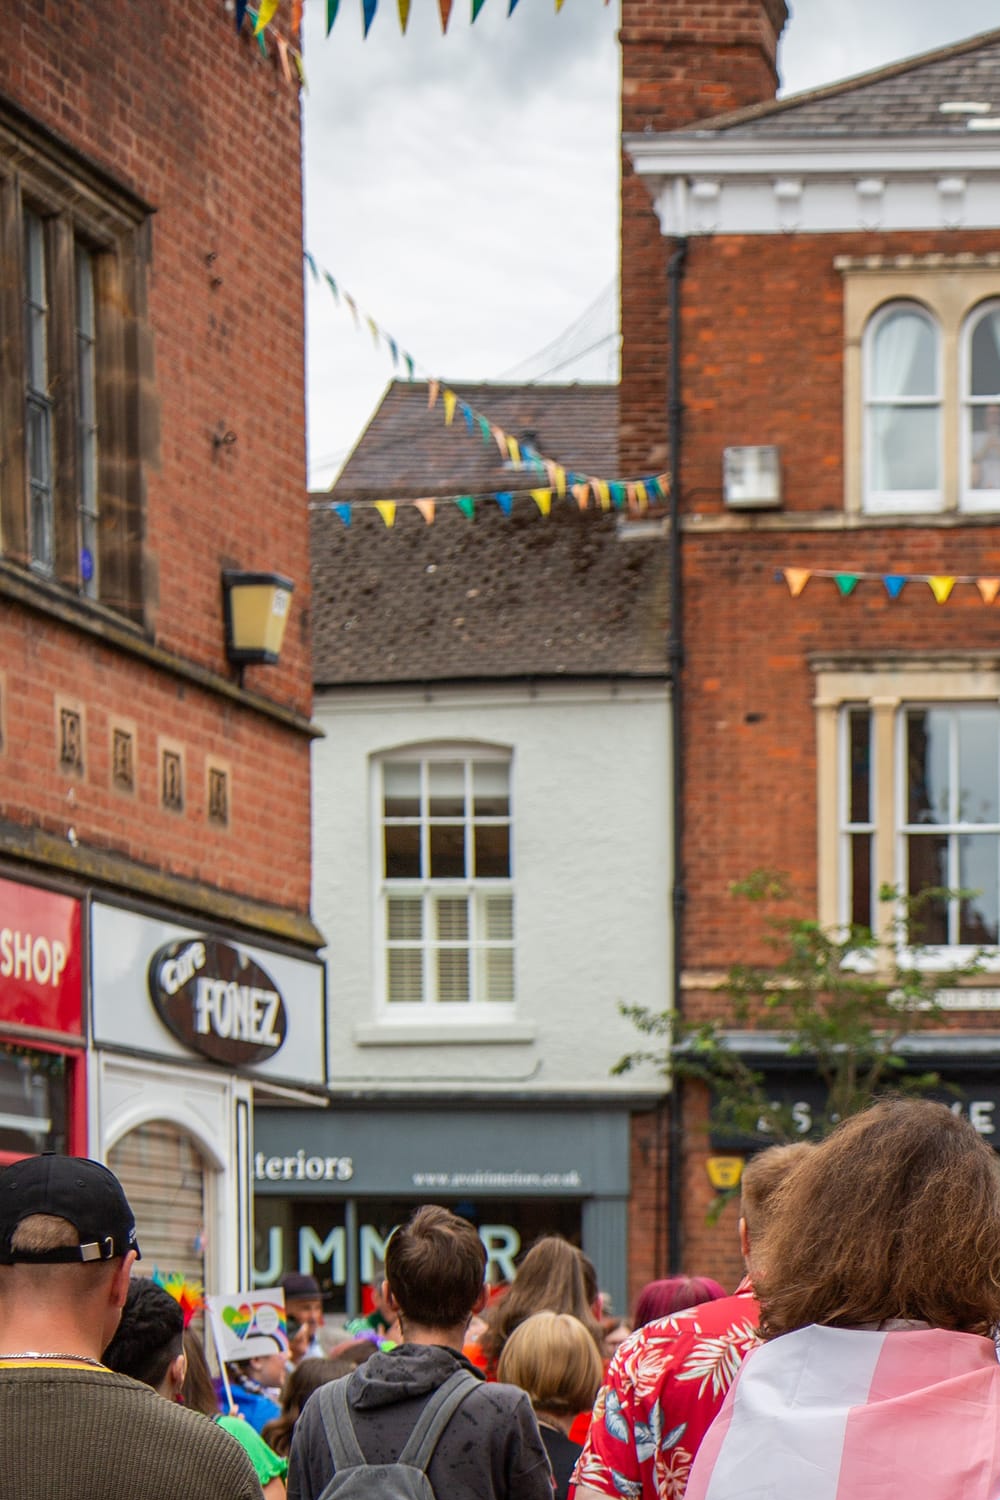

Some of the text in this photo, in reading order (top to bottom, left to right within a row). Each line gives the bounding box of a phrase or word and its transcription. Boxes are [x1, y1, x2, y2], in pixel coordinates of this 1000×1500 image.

[0, 928, 66, 988] SHOP
[196, 976, 281, 1047] FONEZ
[251, 1150, 353, 1182] teriors
[251, 1224, 521, 1287] UMMR
